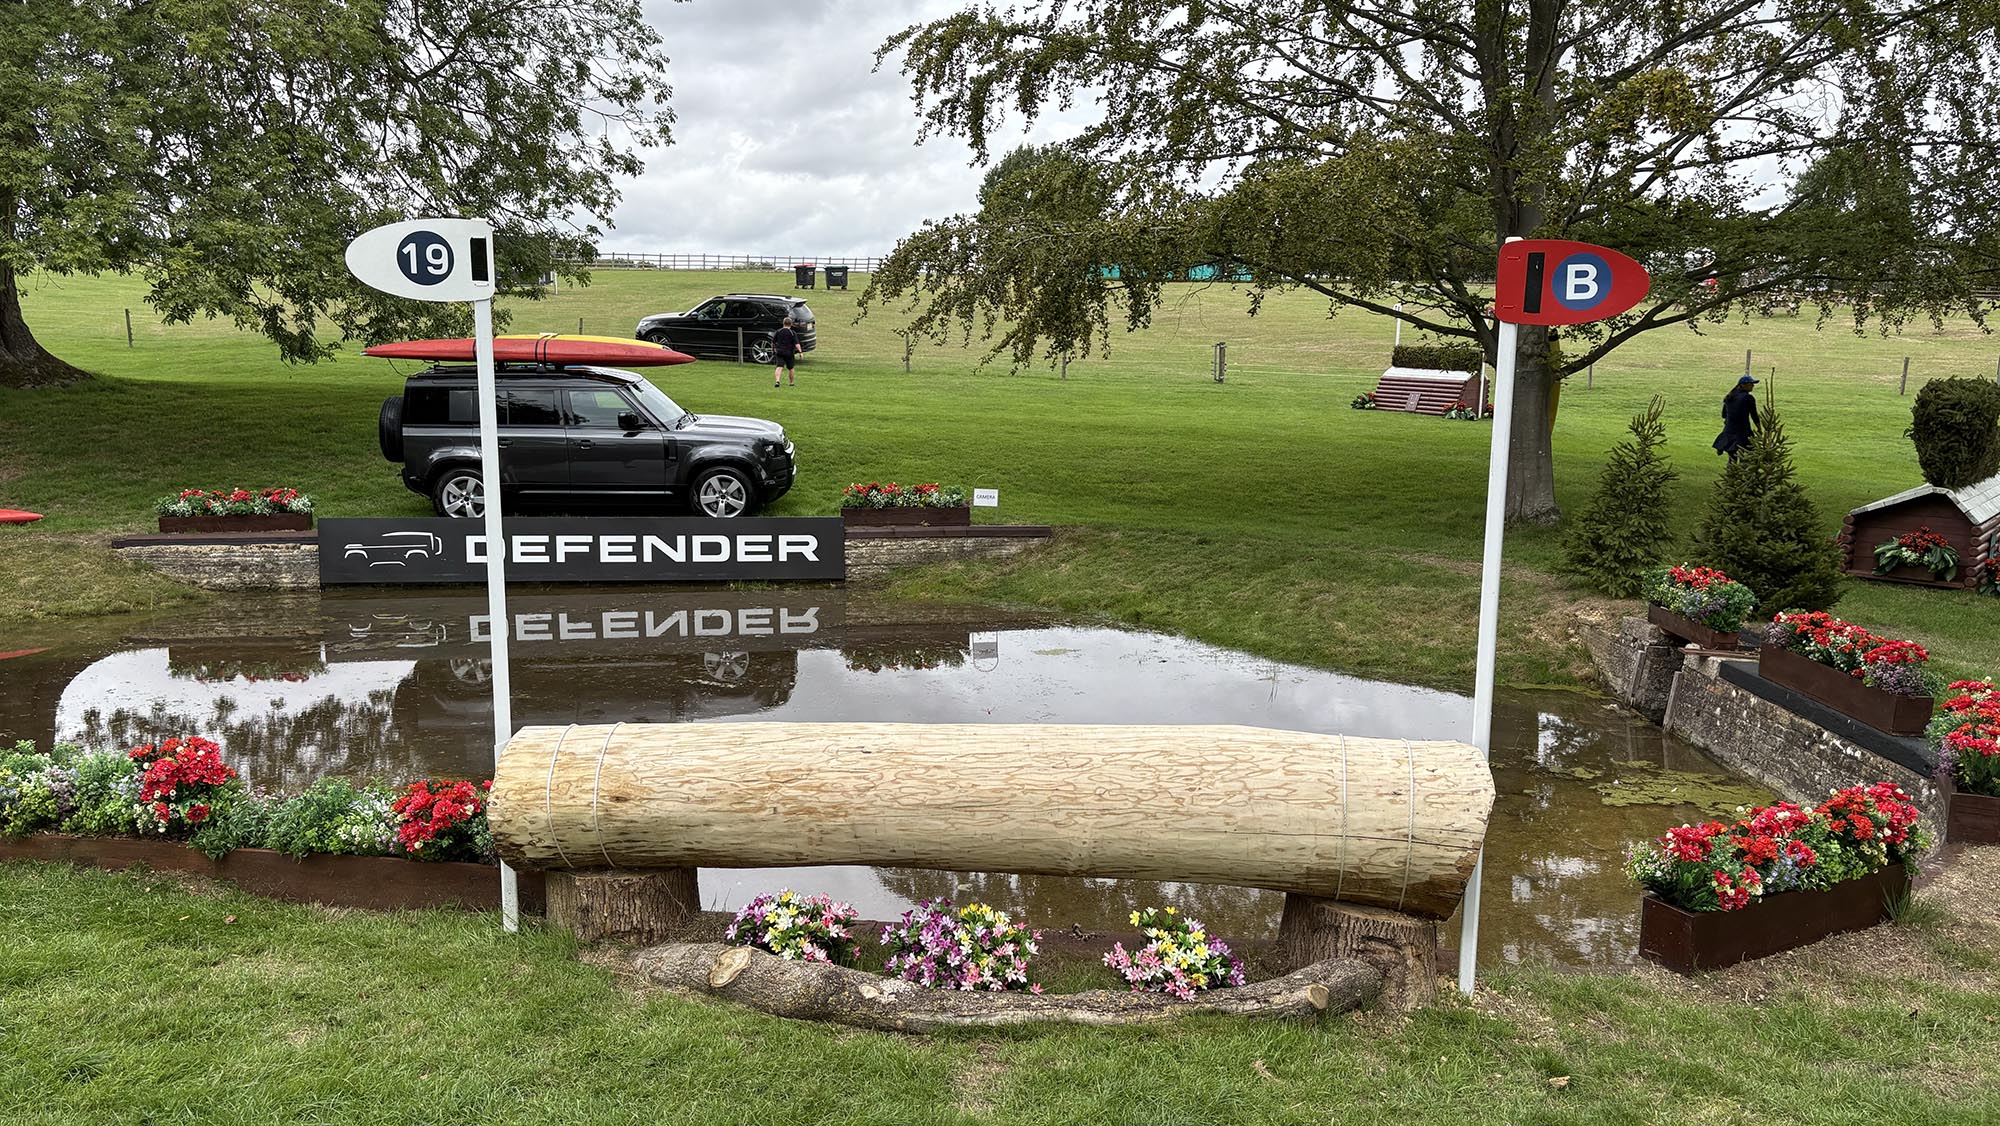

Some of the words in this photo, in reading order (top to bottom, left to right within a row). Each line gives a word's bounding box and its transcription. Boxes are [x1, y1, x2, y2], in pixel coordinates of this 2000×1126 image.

[402, 243, 449, 275] 19
[1565, 263, 1599, 300] B
[465, 534, 820, 563] DEFENDER
